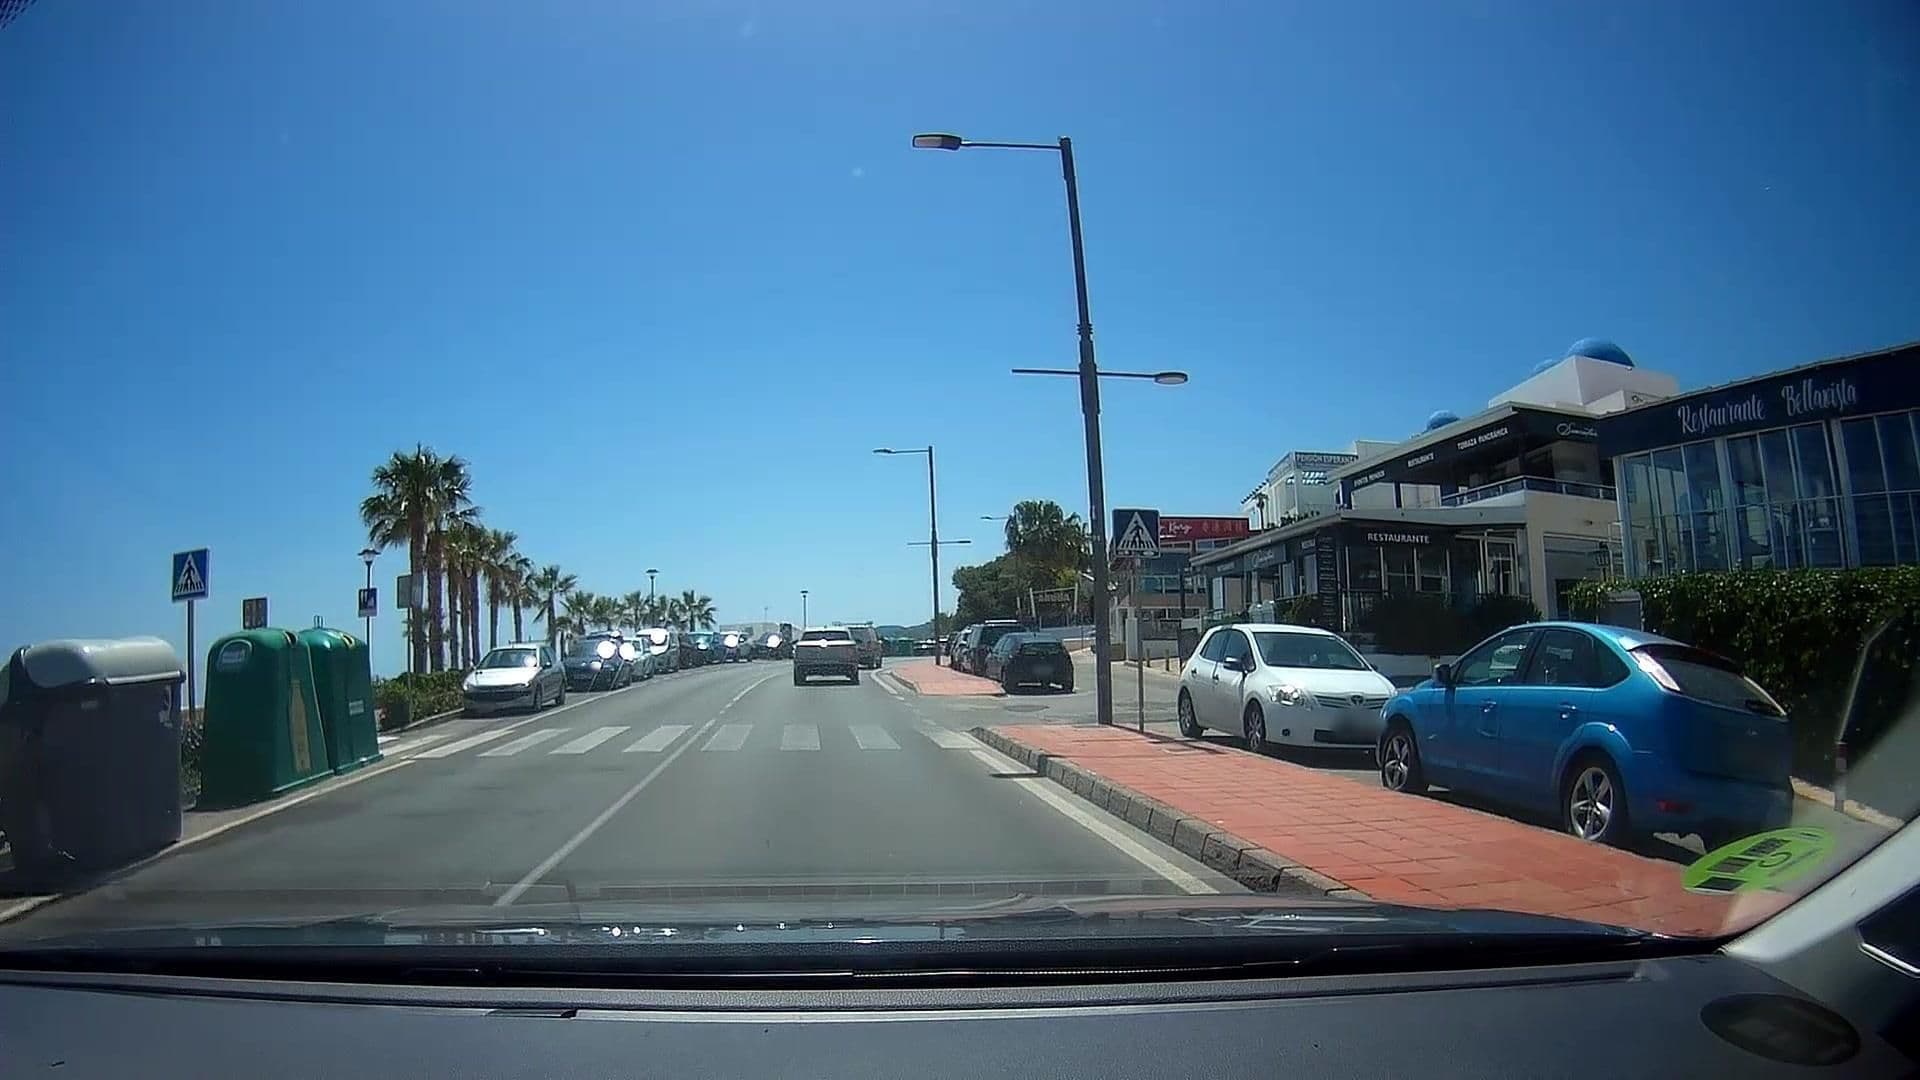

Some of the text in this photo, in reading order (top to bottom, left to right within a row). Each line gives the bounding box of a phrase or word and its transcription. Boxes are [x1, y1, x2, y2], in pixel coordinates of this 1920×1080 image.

[1678, 377, 1857, 434] Restaurante Bellavista
[1367, 533, 1430, 544] RESTAURANTE
